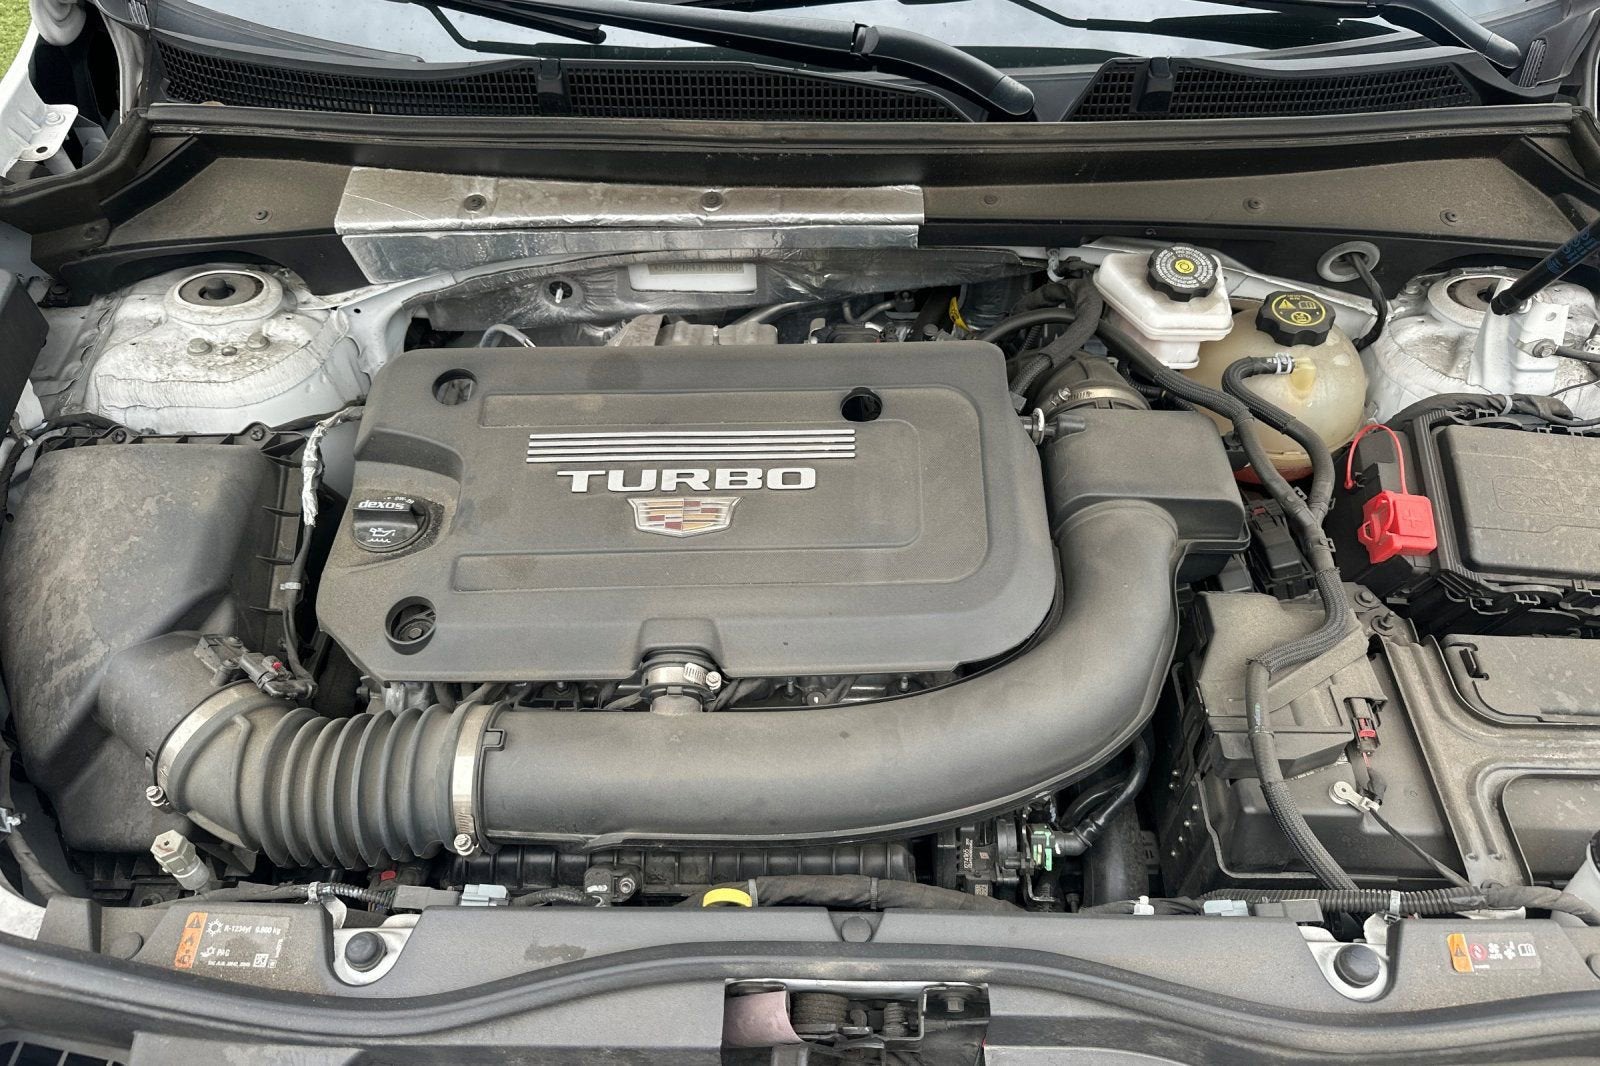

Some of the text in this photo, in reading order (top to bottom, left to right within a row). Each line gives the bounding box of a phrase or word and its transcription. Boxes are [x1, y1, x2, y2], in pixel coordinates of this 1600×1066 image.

[556, 467, 816, 493] TURBO
[358, 499, 405, 510] dexos
[224, 925, 252, 934] R-1234yf
[217, 948, 231, 957] PAG
